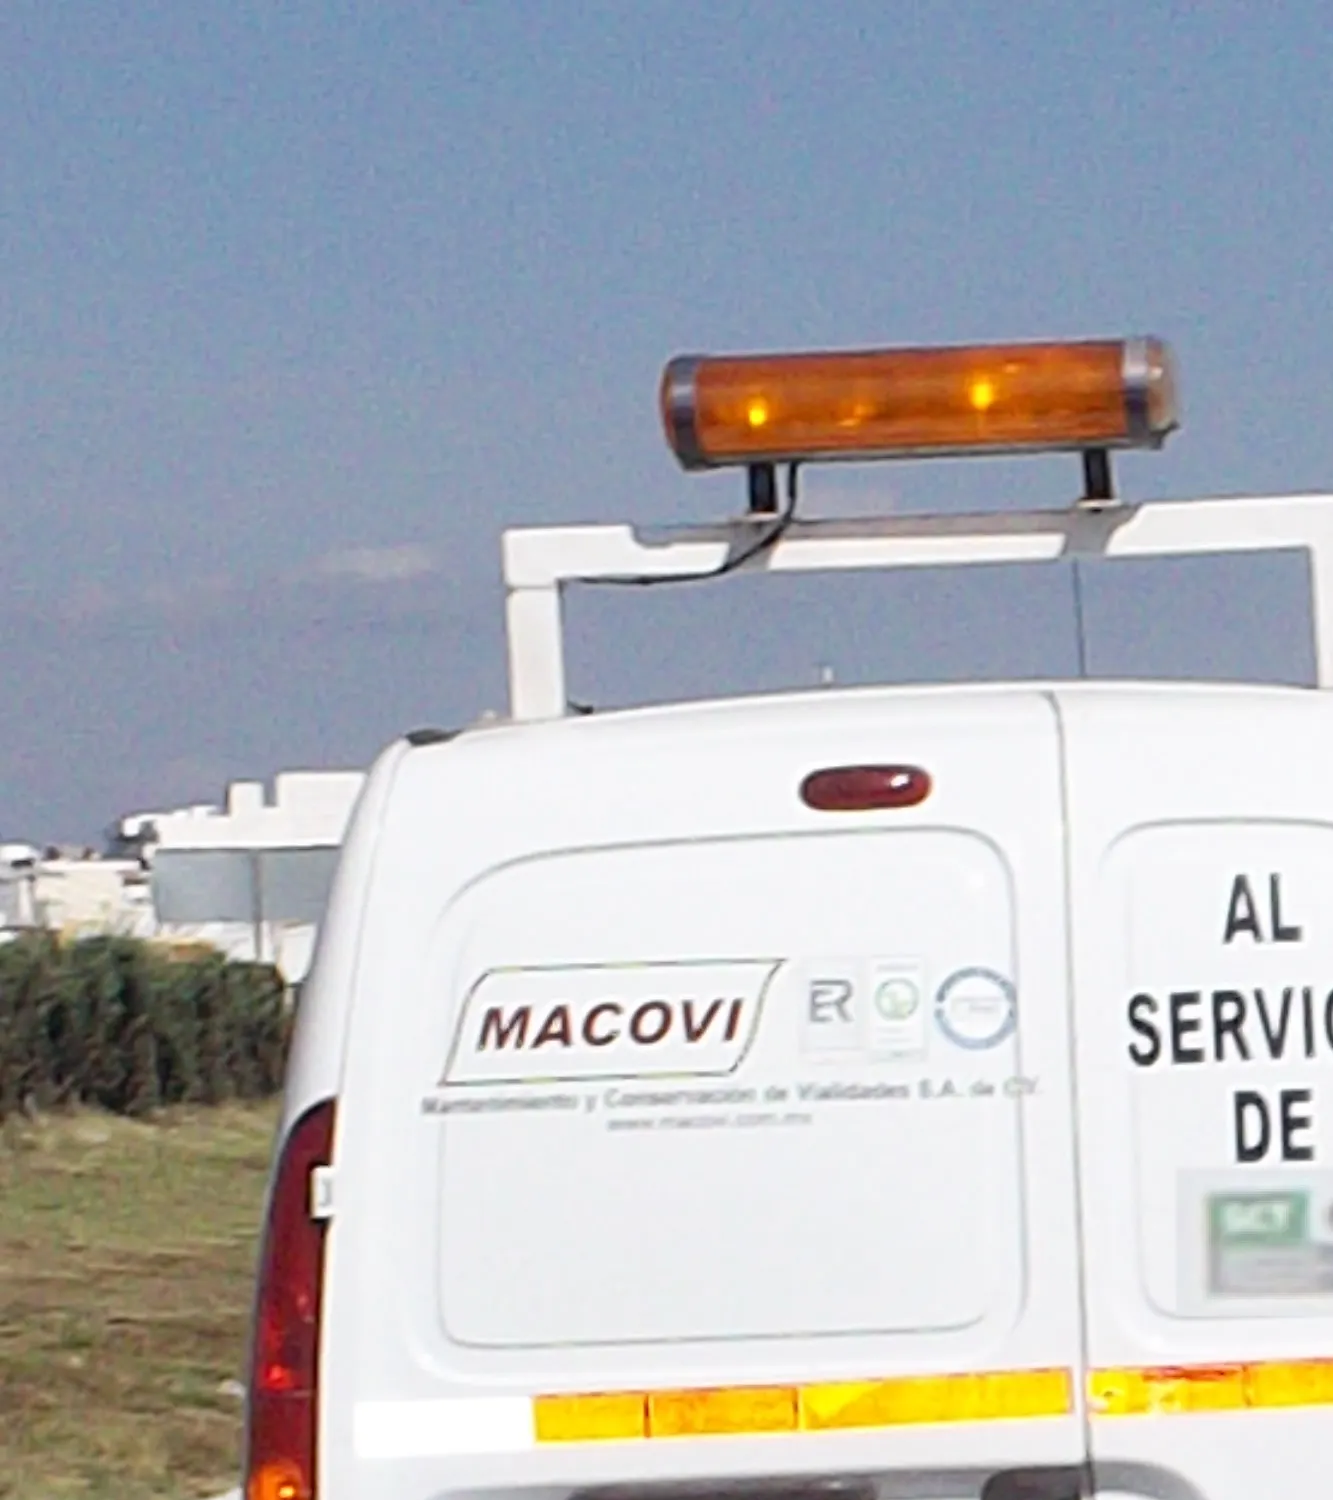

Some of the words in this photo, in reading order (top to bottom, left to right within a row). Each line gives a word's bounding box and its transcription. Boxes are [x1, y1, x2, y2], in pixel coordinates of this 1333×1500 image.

[1223, 873, 1302, 944] AL
[477, 996, 744, 1050] MACOVI
[1233, 1088, 1314, 1164] DE
